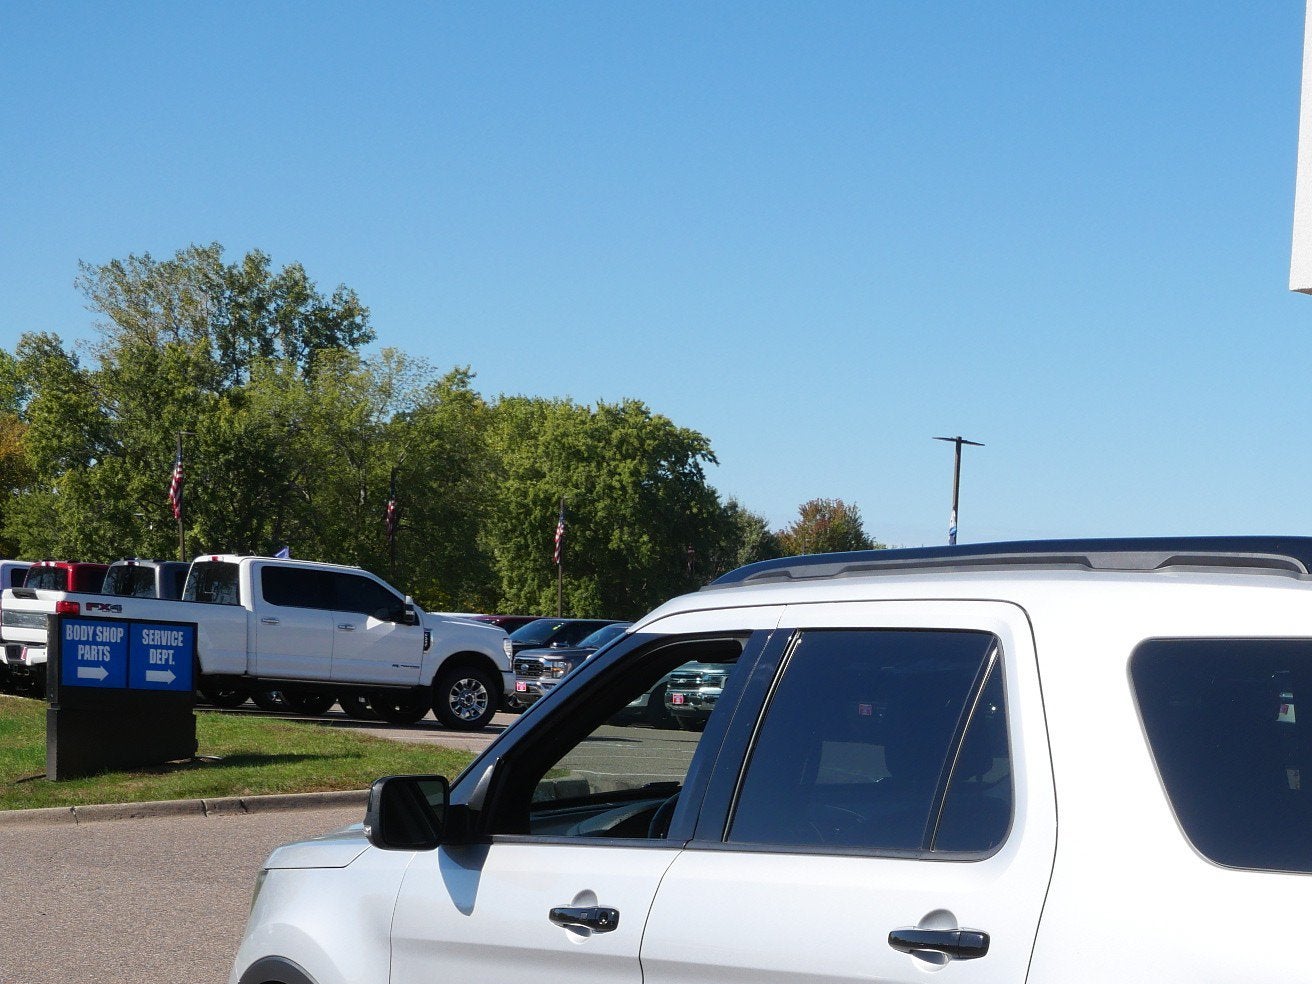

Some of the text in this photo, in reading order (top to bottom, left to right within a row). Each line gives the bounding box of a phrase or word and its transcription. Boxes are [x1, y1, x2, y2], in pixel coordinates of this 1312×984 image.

[86, 602, 123, 613] FX4
[65, 624, 124, 642] BODY SHOP
[142, 628, 184, 646] SERVICE
[78, 644, 111, 661] PARTS
[149, 649, 175, 665] DEPT.
